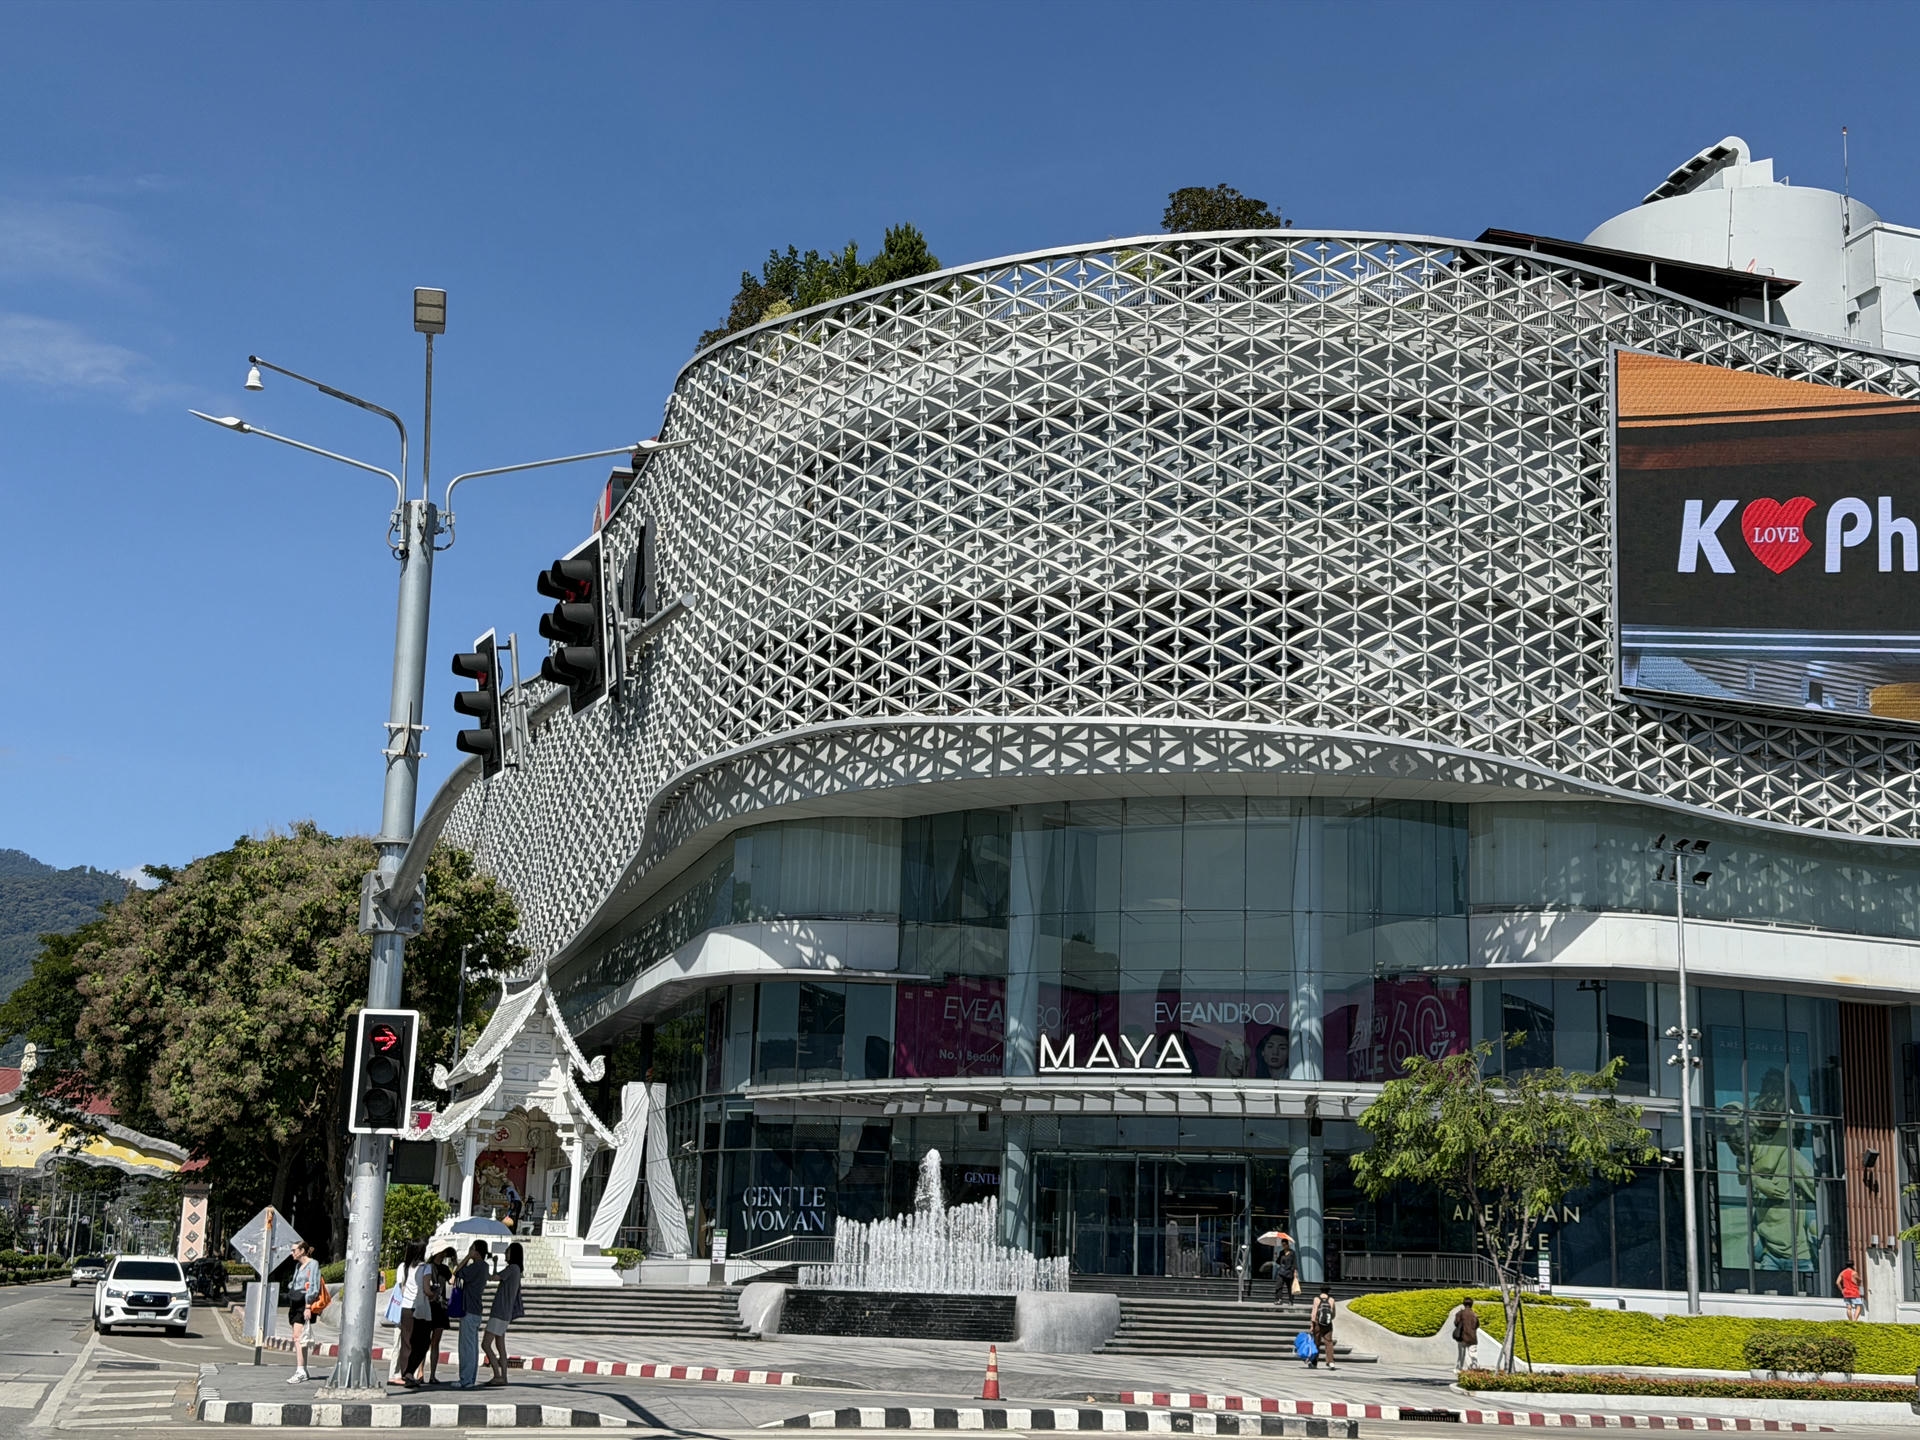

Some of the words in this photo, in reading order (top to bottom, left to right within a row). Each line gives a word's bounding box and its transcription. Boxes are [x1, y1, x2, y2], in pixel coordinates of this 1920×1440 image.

[1677, 499, 1740, 574] K
[1753, 526, 1800, 543] LOVE
[943, 996, 1069, 1030] EVEABOY
[1154, 1001, 1286, 1025] EVEANDBOY
[966, 1050, 1001, 1064] Beauty
[1039, 1033, 1191, 1069] MAYA
[1353, 1044, 1385, 1079] SALE
[743, 1186, 826, 1207] GENTLE
[742, 1210, 826, 1231] WOMAN
